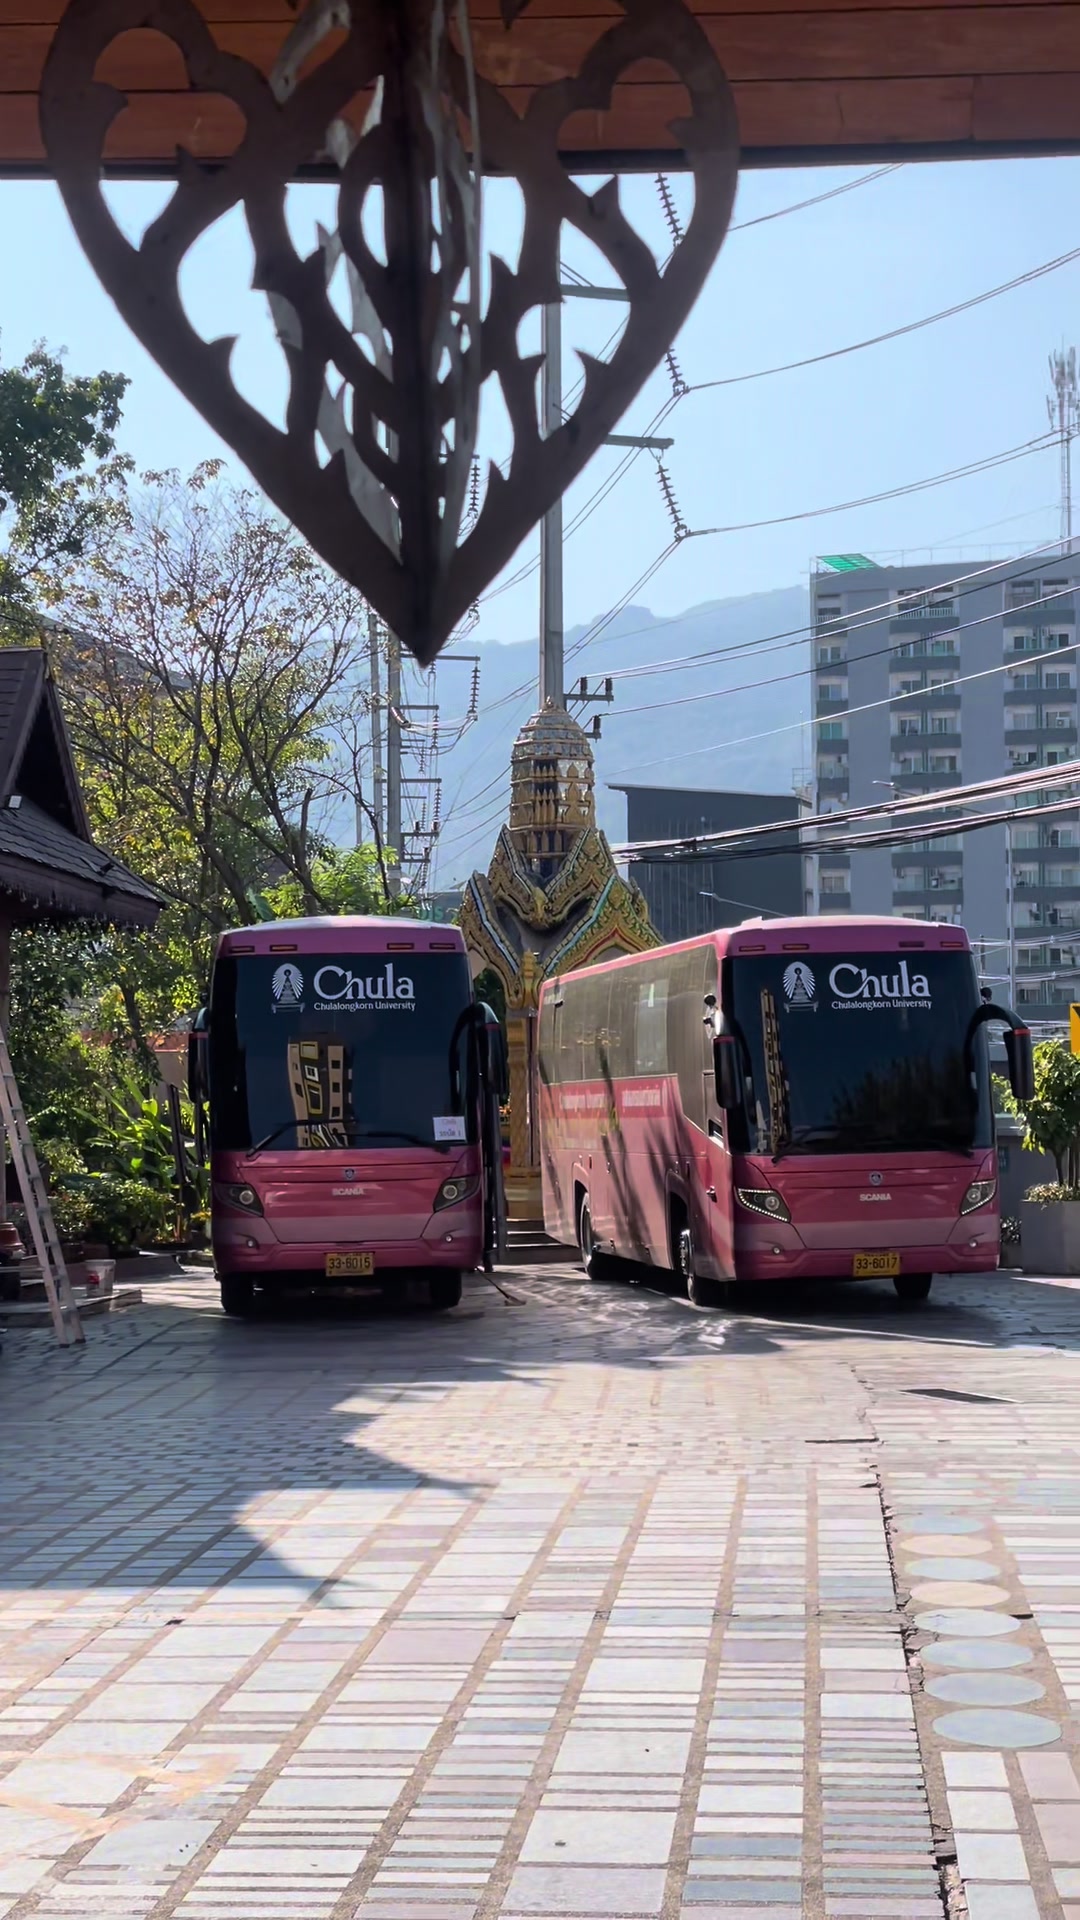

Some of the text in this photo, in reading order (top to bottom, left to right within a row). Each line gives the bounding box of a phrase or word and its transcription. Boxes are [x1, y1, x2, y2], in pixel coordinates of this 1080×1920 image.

[313, 962, 416, 1000] Chula
[829, 960, 932, 998] Chula
[313, 1001, 416, 1012] Chulalongkorn University
[831, 999, 933, 1011] Chulalongkorn University
[332, 1188, 365, 1196] SCANIA
[859, 1193, 892, 1201] SCANIA
[328, 1257, 371, 1269] 33-6015
[856, 1257, 898, 1269] 33-6017
